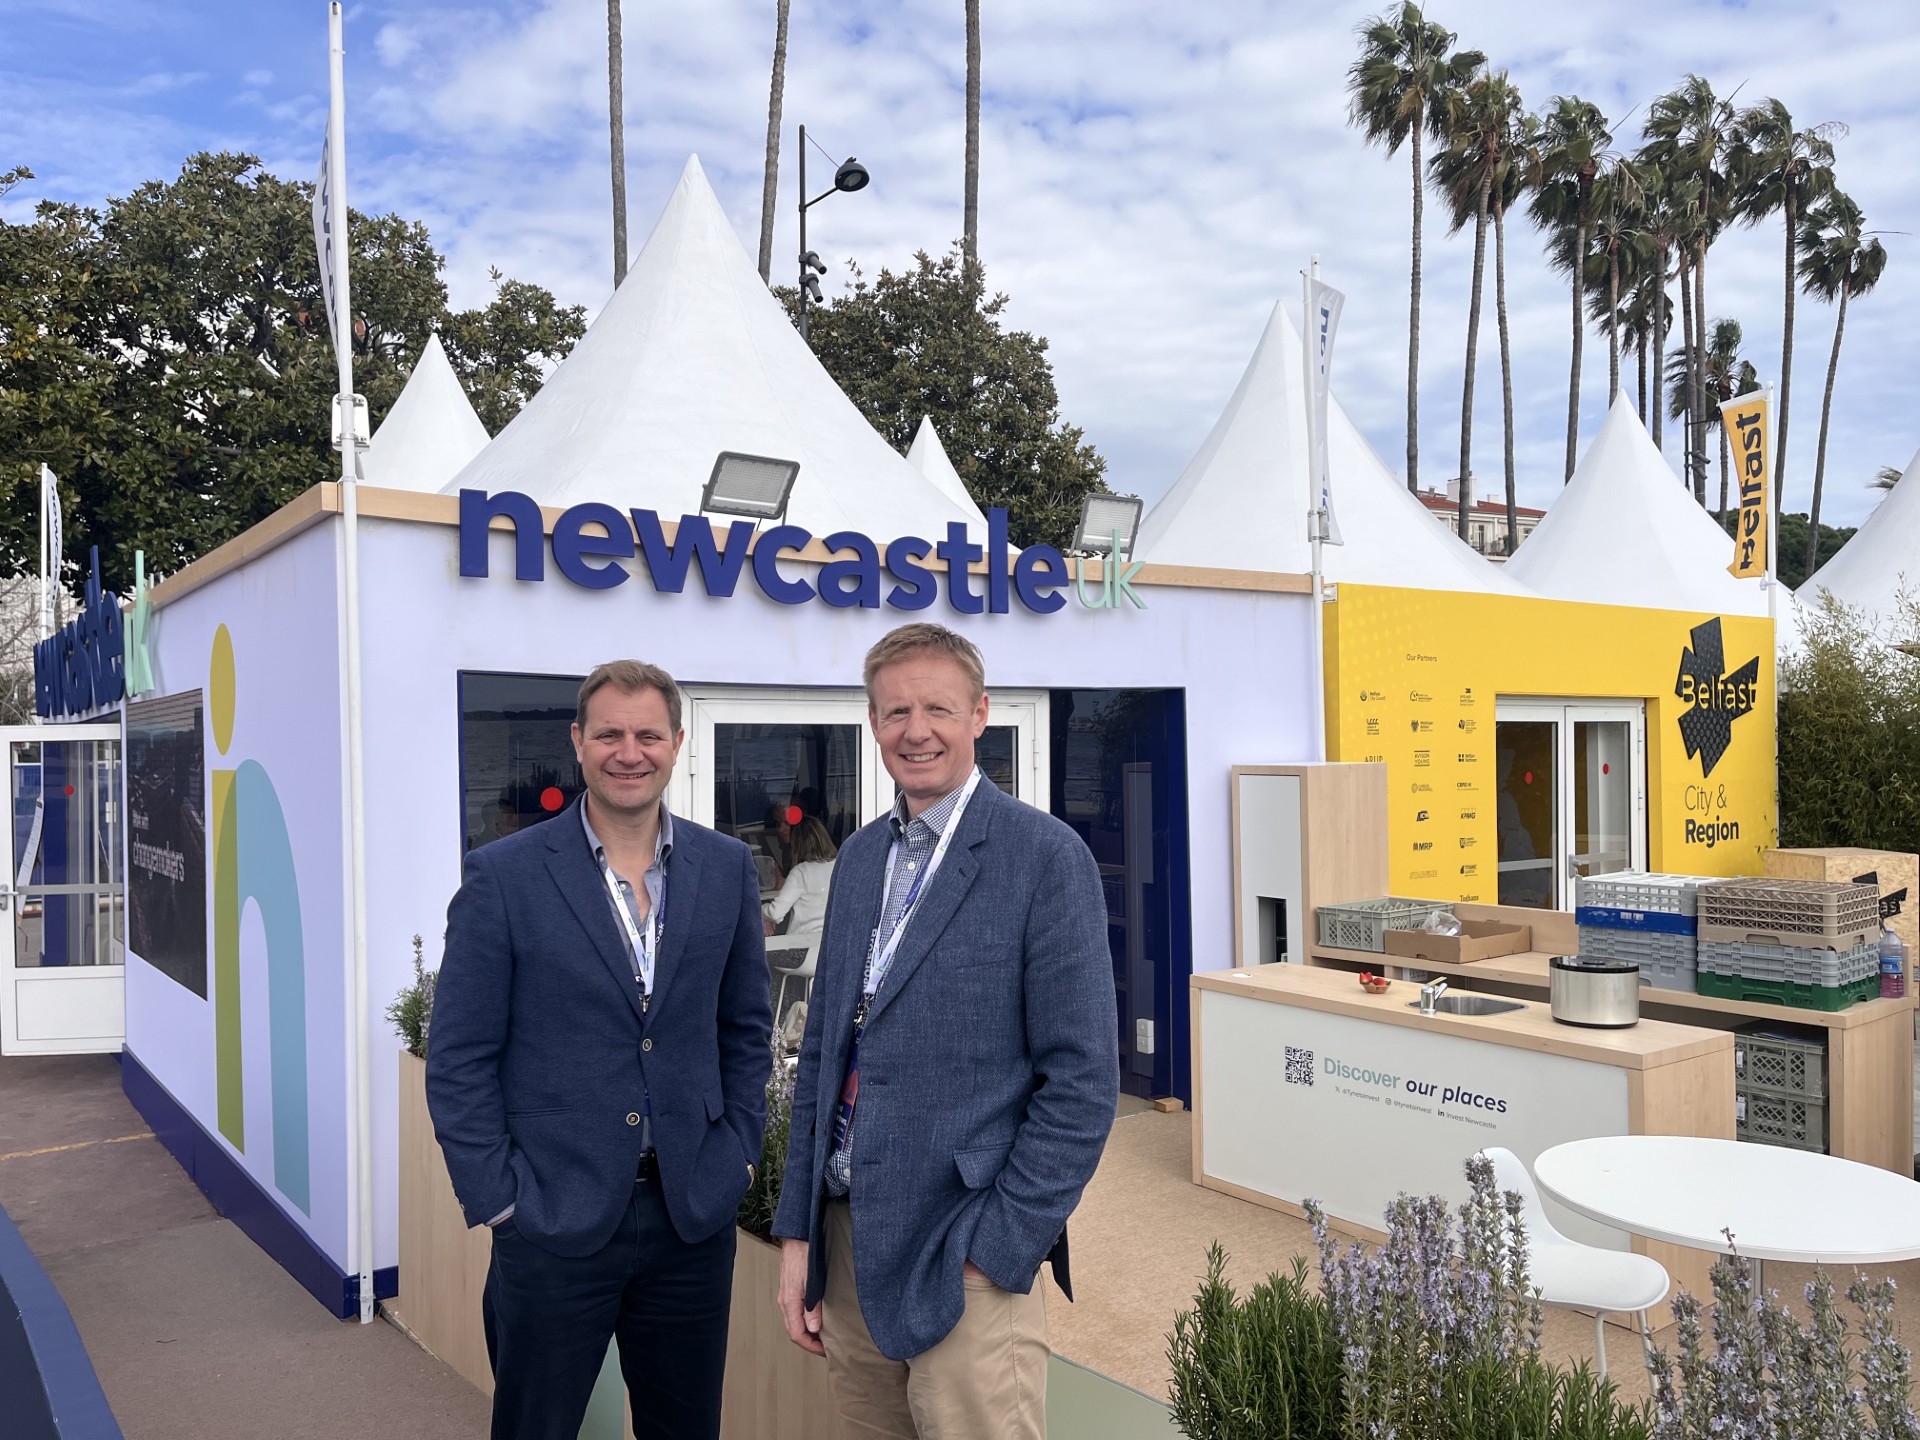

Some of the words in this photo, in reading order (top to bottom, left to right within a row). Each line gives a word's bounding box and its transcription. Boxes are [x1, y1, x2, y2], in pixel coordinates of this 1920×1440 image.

[1736, 412, 1763, 571] Belfast
[458, 488, 1069, 616] newcastle
[1075, 529, 1148, 610] uk
[1406, 653, 1416, 661] Our
[1417, 654, 1438, 662] Partners
[1682, 673, 1757, 710] Belfast
[1684, 784, 1713, 816] City
[1716, 783, 1727, 808] &
[1419, 842, 1433, 851] MRP
[1685, 815, 1740, 849] Region
[1324, 1057, 1401, 1088] Discover
[1405, 1079, 1438, 1097] our
[1441, 1086, 1507, 1113] places
[1464, 1116, 1497, 1129] Newcastle
